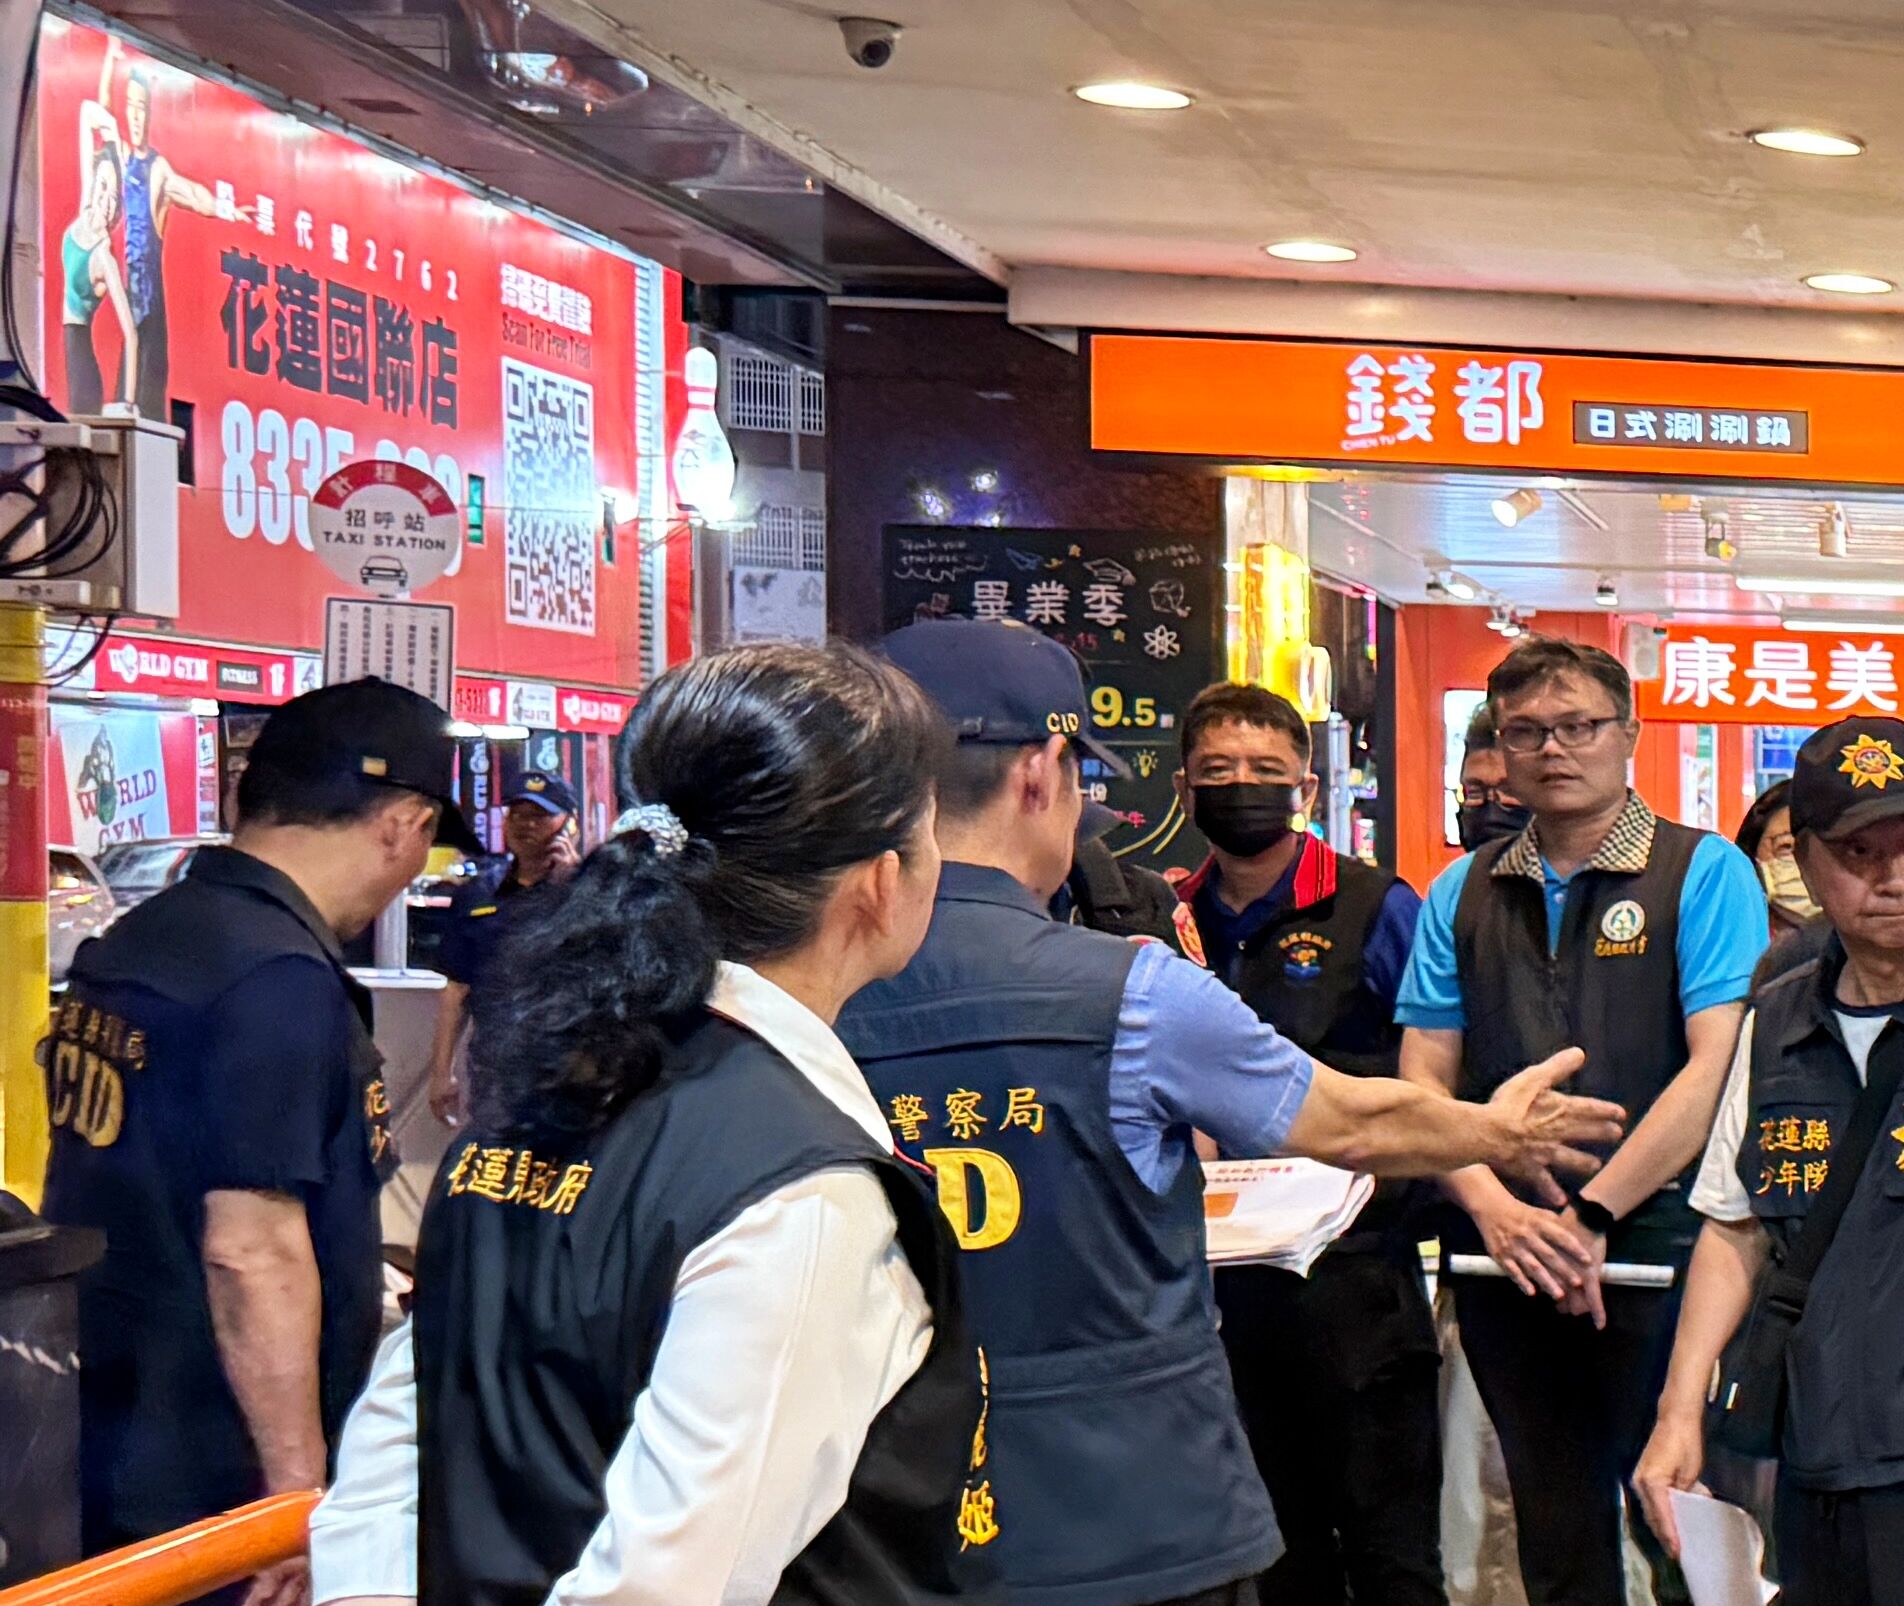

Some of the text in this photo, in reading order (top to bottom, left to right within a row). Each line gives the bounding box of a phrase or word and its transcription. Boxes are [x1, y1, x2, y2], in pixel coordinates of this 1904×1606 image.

[220, 246, 459, 431] 花蓮國聯店
[1345, 354, 1545, 446] 錢都
[1589, 407, 1792, 447] 日式涮涮鍋
[323, 530, 446, 551] TAXI STATION
[345, 508, 426, 532] 招呼站
[971, 579, 1129, 627] 畢業季
[1662, 636, 1899, 712] 康是美
[1046, 712, 1080, 733] CID
[1091, 686, 1157, 727] 9.5
[888, 1086, 1045, 1142] 警察局
